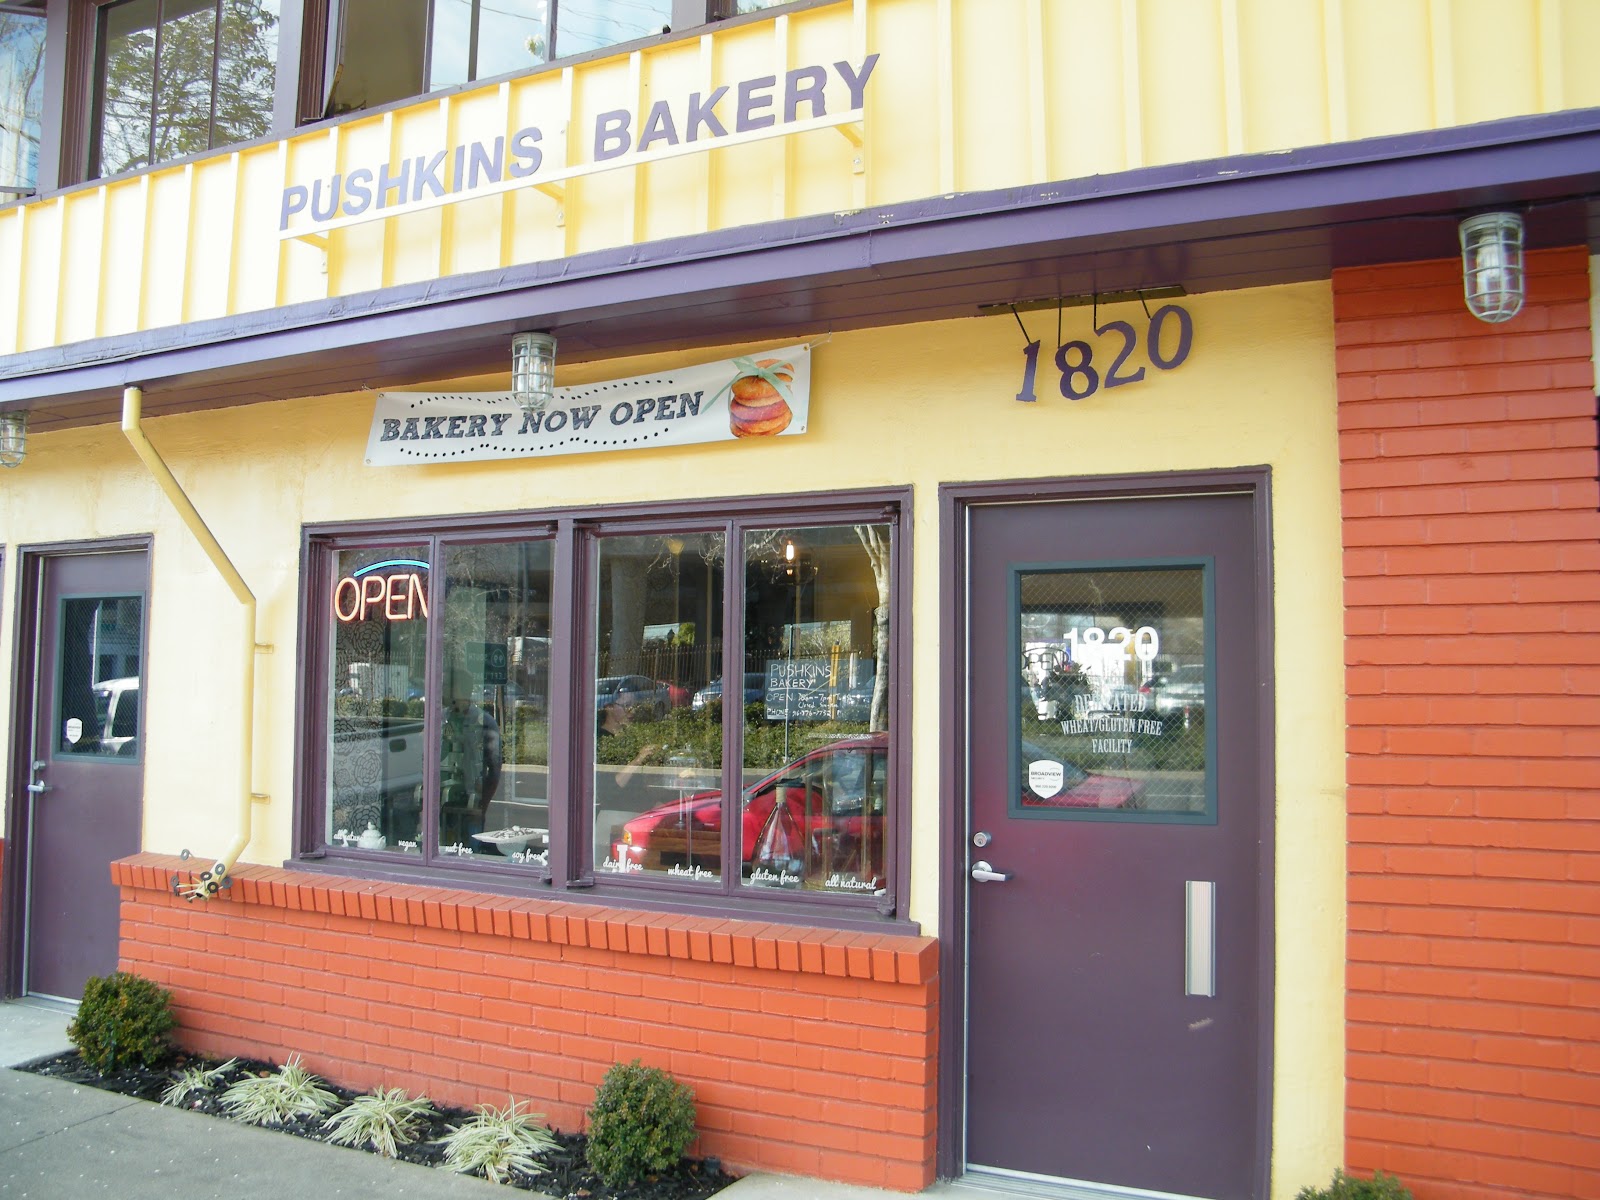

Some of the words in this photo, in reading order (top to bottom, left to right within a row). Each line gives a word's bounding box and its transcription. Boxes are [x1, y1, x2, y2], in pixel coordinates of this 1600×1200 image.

[279, 126, 543, 230] PUSHKINS
[594, 53, 880, 162] BAKERY
[1016, 304, 1193, 402] 1820
[380, 413, 513, 442] BAKERY
[516, 404, 602, 436] NOW
[608, 390, 704, 426] OPEN
[334, 573, 428, 621] OPEN
[1063, 626, 1159, 663] 1820
[1074, 693, 1147, 712] DEATED
[1060, 718, 1136, 736] WHEAT/GLUTEN
[1137, 718, 1163, 736] FREE
[1092, 738, 1133, 754] FACILITY
[398, 840, 417, 852] vegan
[445, 842, 457, 853] nut
[458, 842, 473, 856] free
[512, 851, 525, 863] soy
[526, 848, 542, 862] free
[602, 856, 621, 872] dair
[626, 858, 643, 873] free
[667, 863, 693, 877] wheat
[694, 865, 713, 881] free
[749, 868, 779, 885] gluten
[780, 870, 800, 885] free
[825, 874, 839, 887] all
[840, 876, 876, 890] natural
